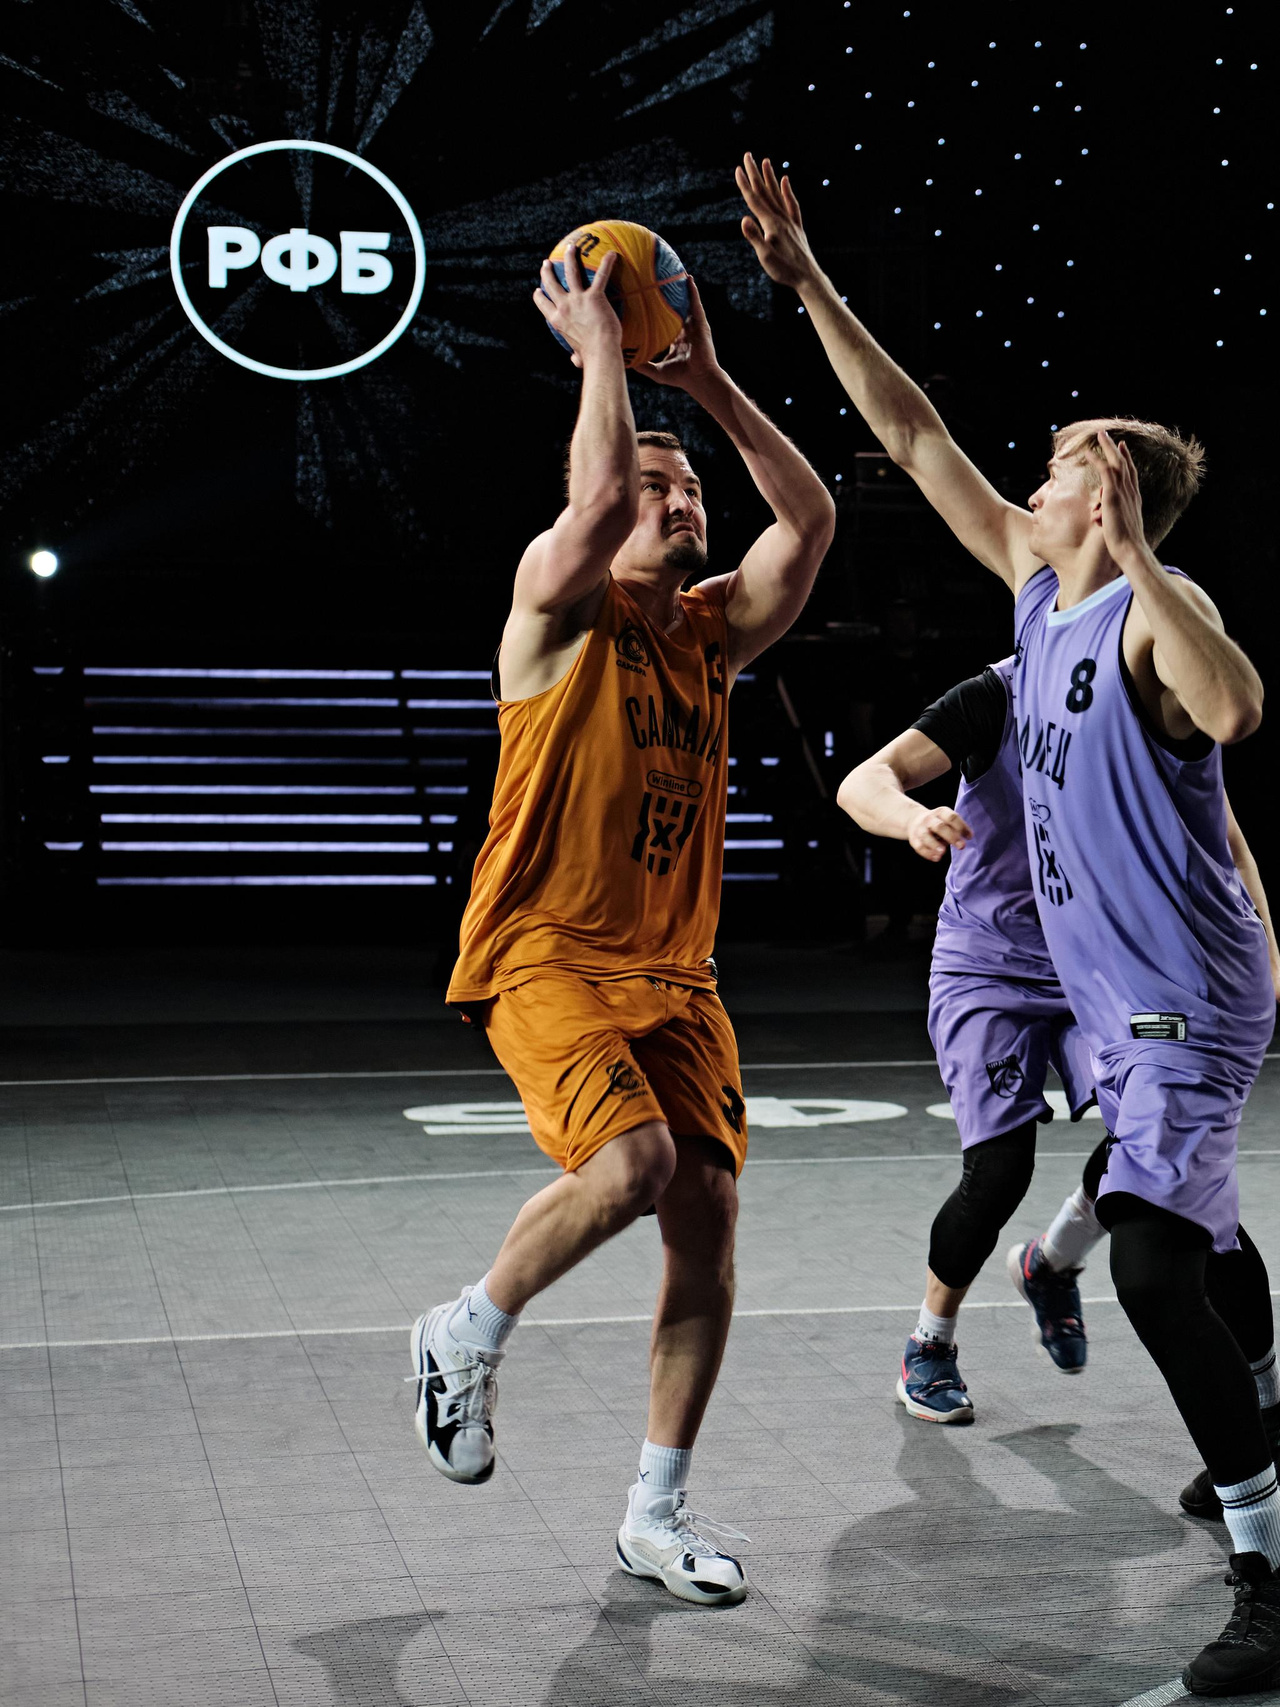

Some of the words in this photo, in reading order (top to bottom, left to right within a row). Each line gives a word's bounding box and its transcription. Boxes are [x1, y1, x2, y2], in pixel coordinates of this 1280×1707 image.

[207, 226, 394, 294] РФБ
[1065, 658, 1097, 714] 8
[652, 773, 685, 792] Winline
